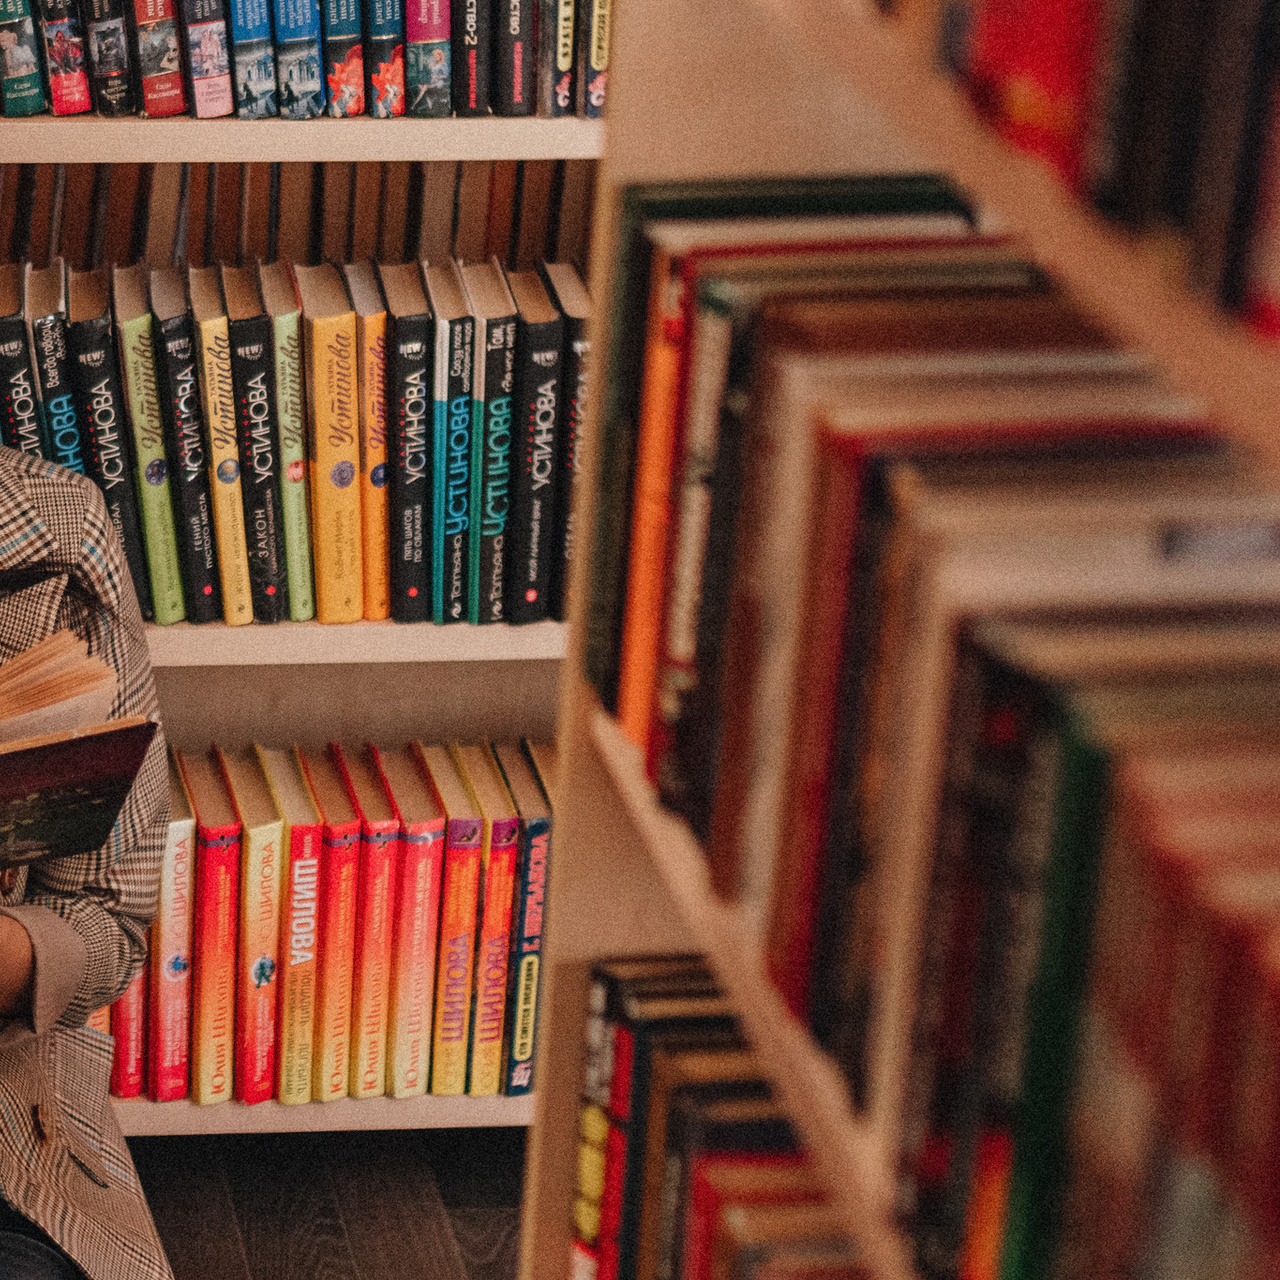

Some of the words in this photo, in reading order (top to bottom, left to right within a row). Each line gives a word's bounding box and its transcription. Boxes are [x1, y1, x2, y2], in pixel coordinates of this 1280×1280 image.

[91, 379, 124, 489] УСТИНОВА
[405, 368, 426, 485] УСТИНОВА
[445, 395, 470, 535] УСТИНОВА
[256, 509, 269, 556] ЗАКОН
[290, 859, 318, 966] ШИЛОВА
